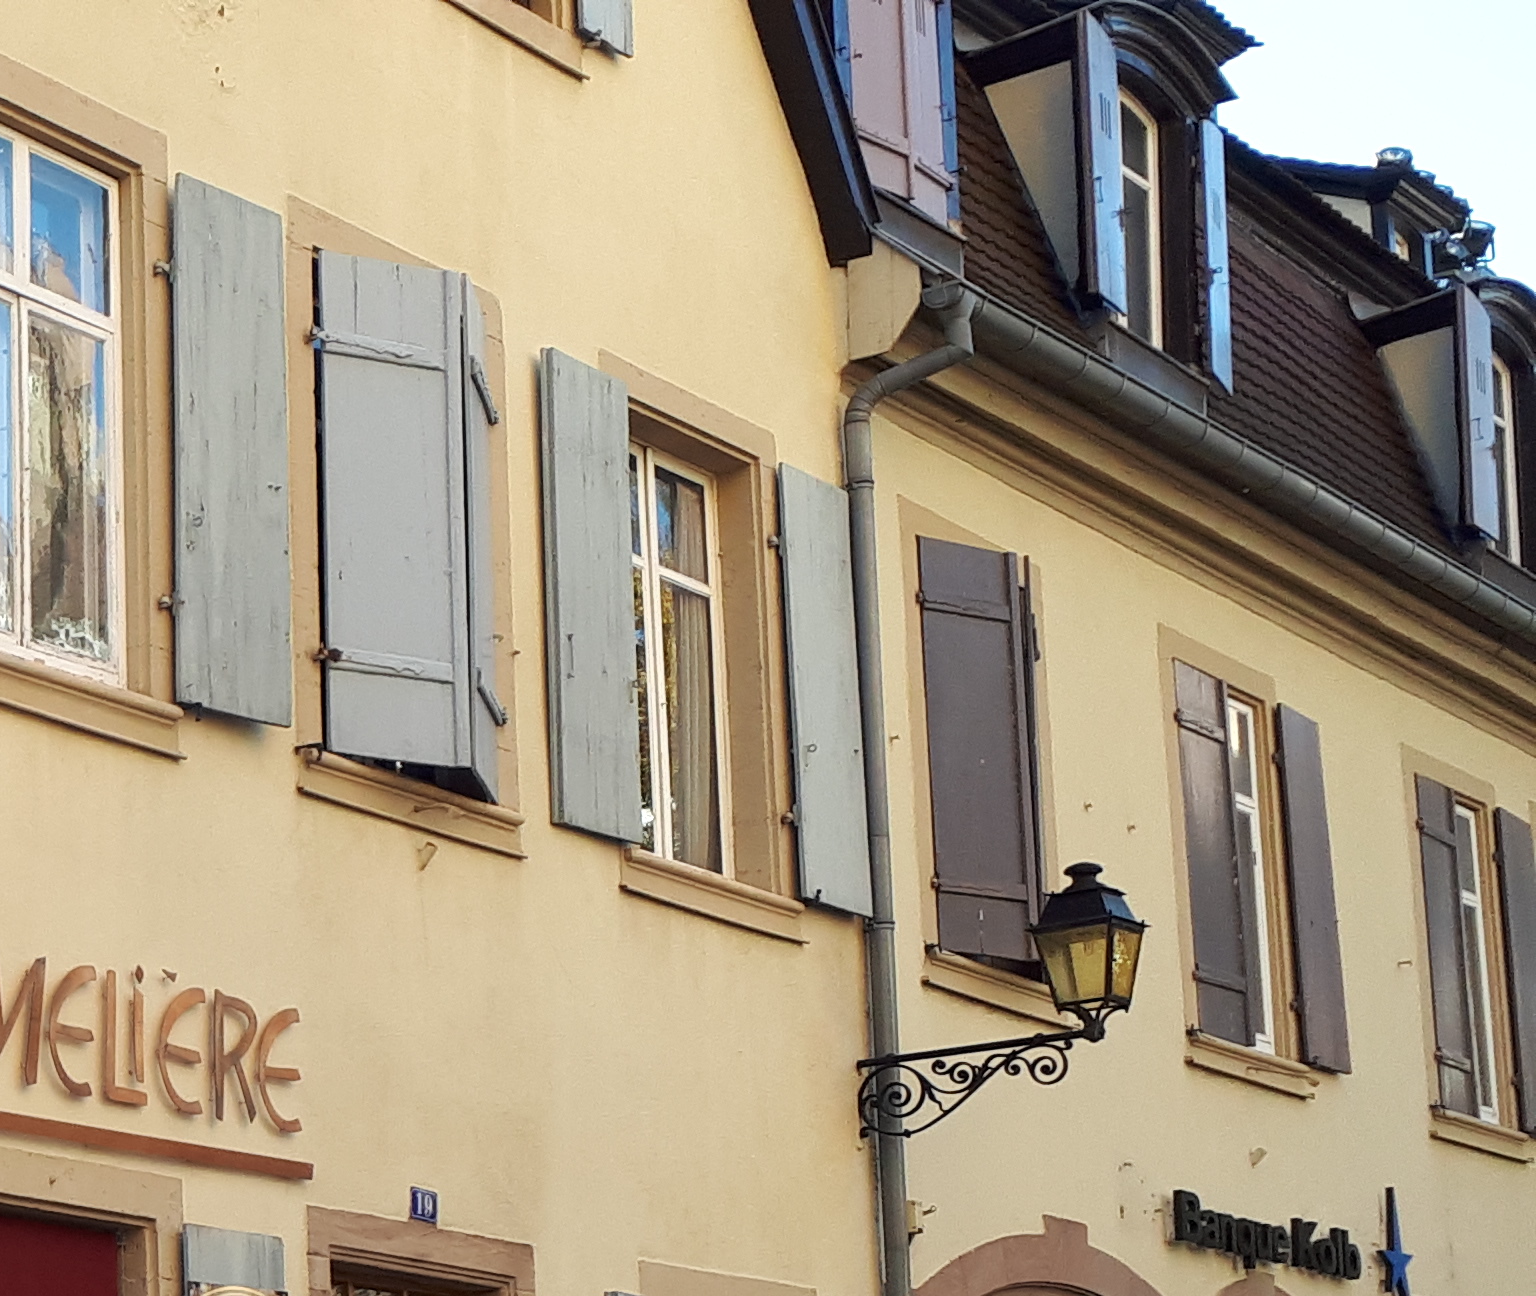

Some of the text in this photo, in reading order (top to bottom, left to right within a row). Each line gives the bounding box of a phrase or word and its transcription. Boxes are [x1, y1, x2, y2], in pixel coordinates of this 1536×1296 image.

[416, 1192, 434, 1218] 19
[1173, 1189, 1362, 1280] Banque Kolb
